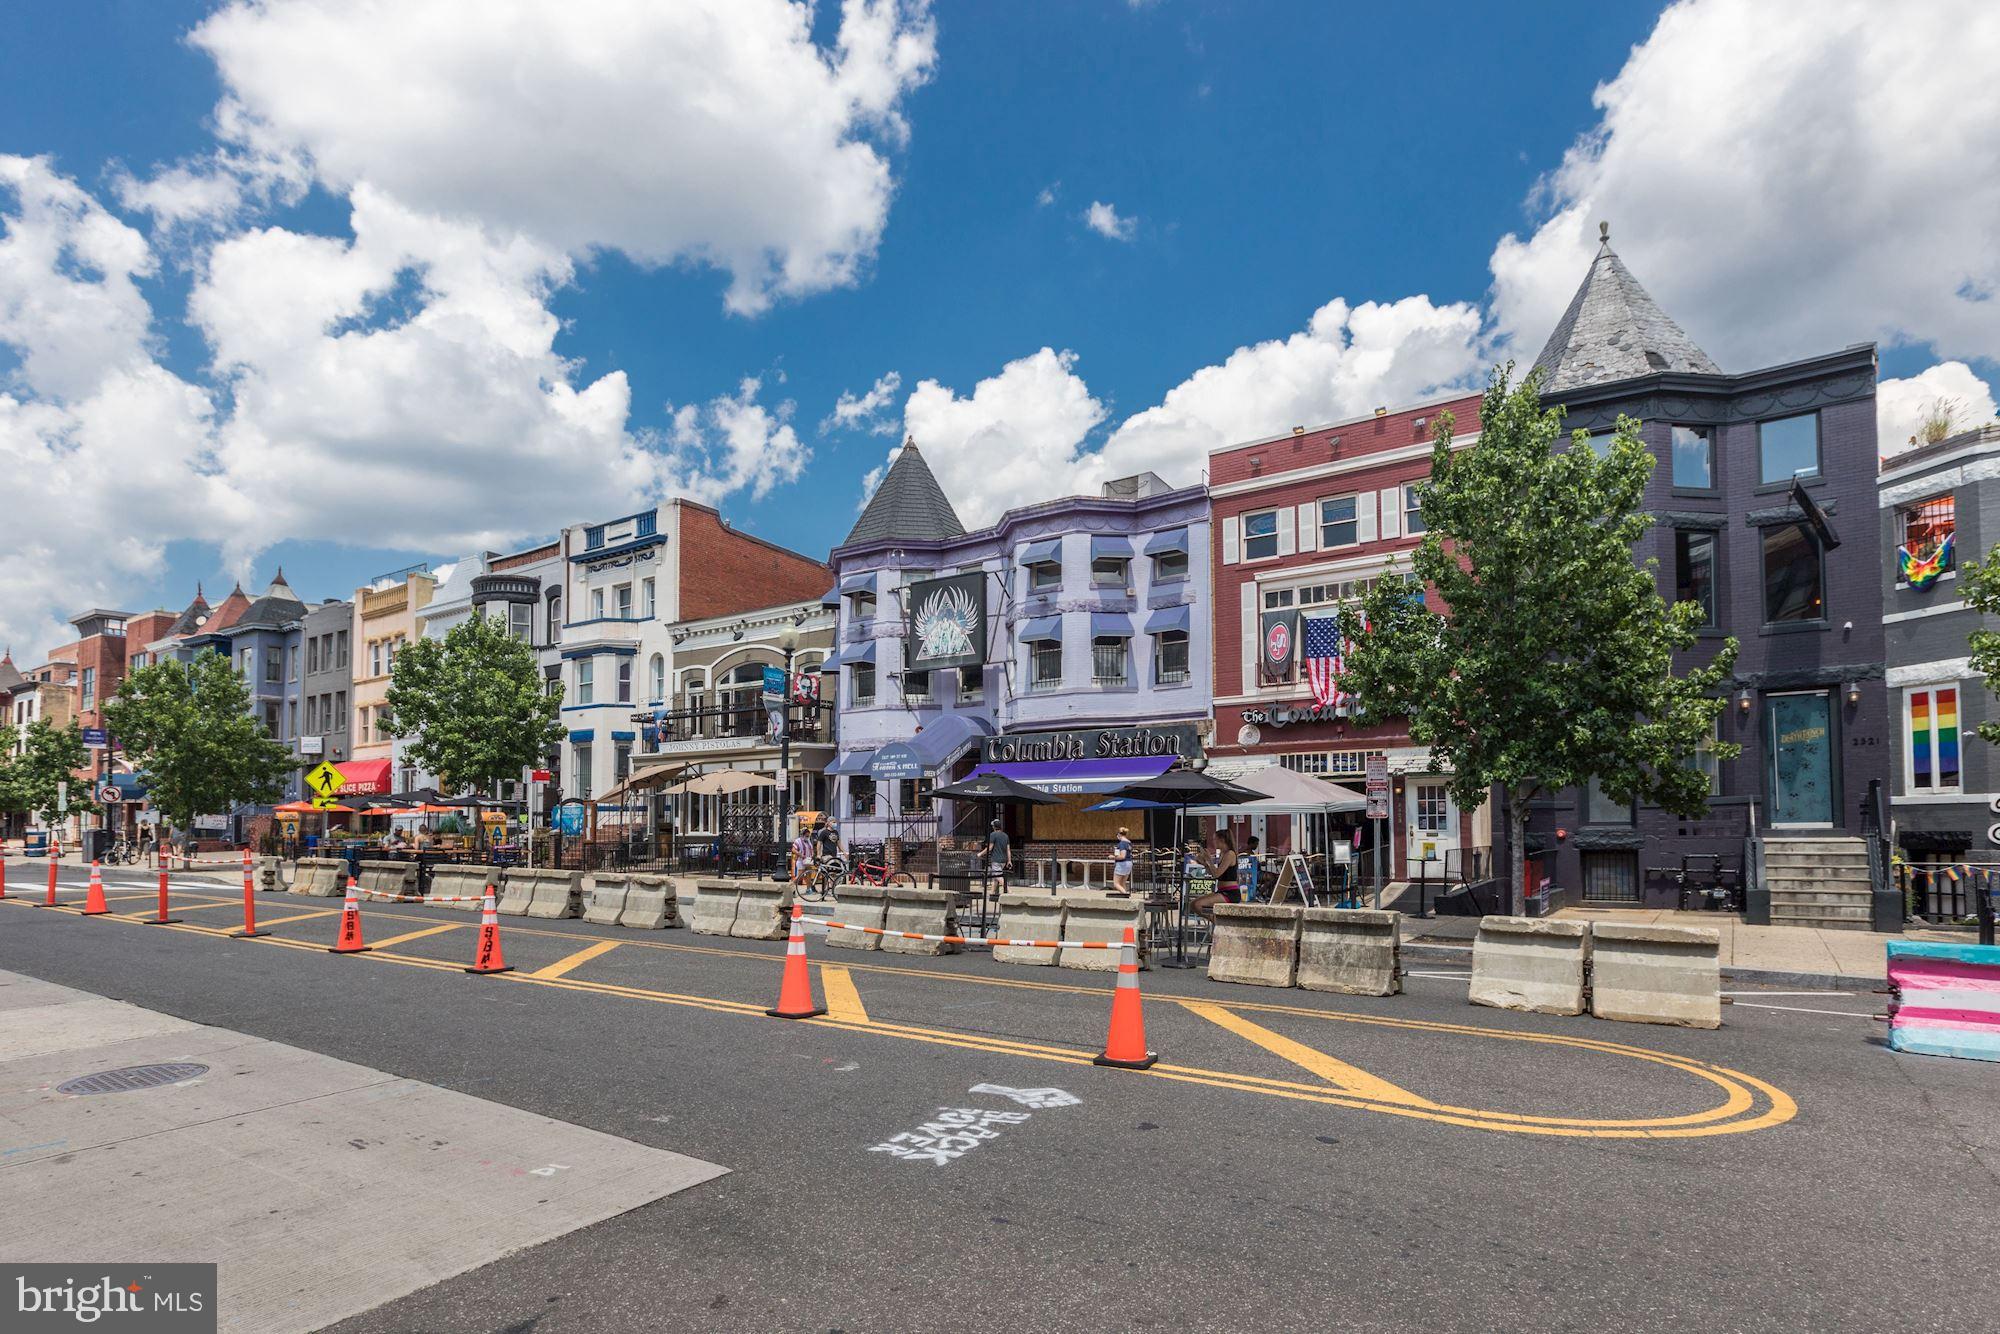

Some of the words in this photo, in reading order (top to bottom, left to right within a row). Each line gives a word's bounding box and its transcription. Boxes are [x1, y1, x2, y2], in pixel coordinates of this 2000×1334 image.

[1242, 709, 1264, 723] The
[702, 740, 741, 750] PISTOLAS
[988, 733, 1085, 762] Columbia
[1095, 729, 1181, 757] Station
[358, 781, 377, 791] PIZZA
[1052, 784, 1083, 793] Station
[924, 1110, 1031, 1166] BLACK
